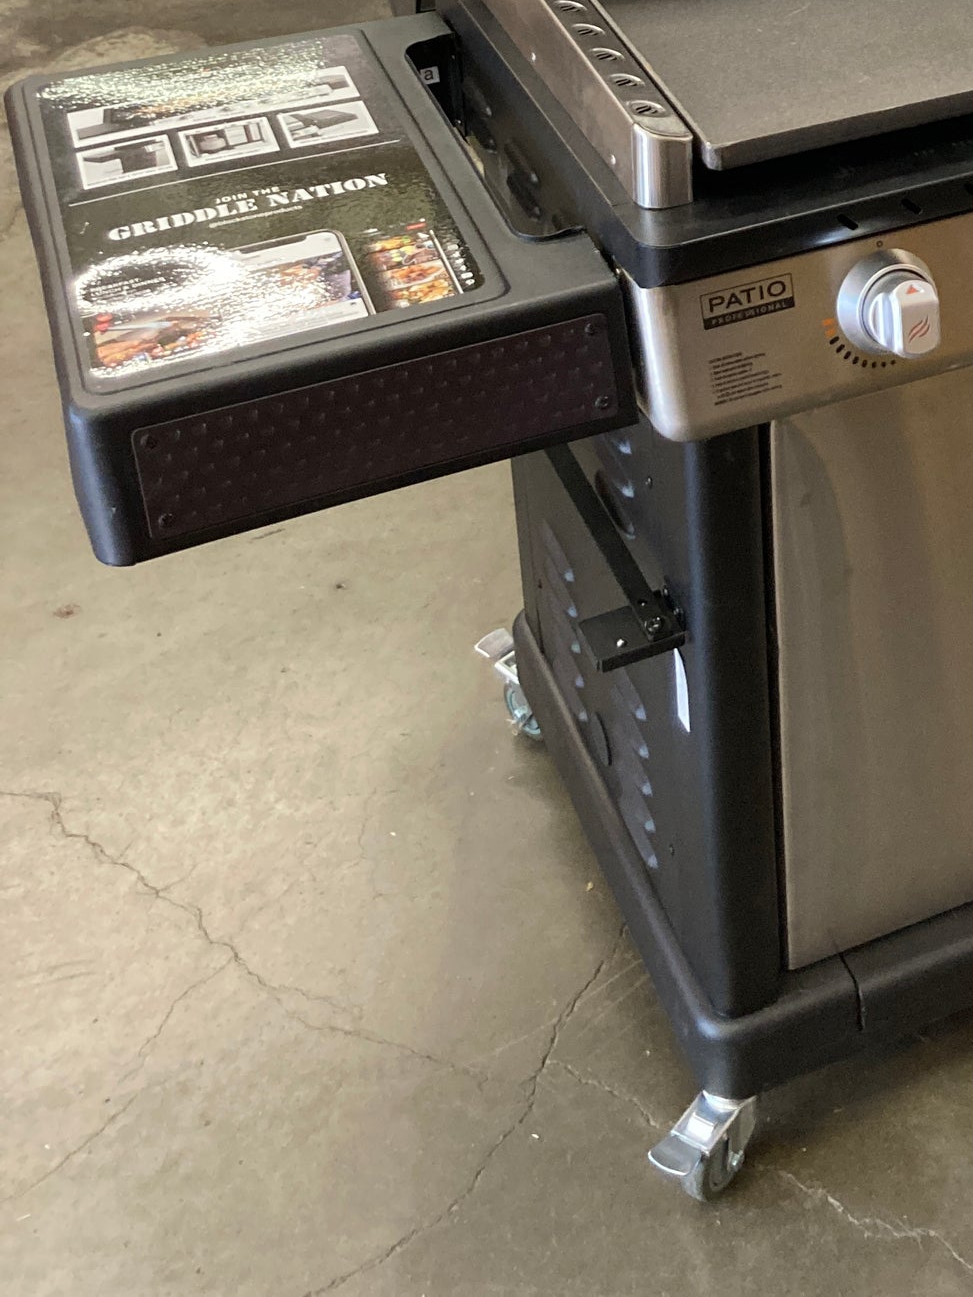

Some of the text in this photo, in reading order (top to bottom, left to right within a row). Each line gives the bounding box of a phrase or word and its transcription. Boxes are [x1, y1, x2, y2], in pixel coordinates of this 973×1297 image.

[108, 172, 389, 241] GRIDDLE NATION
[215, 186, 280, 204] JOIN THE
[708, 280, 786, 313] PATIO
